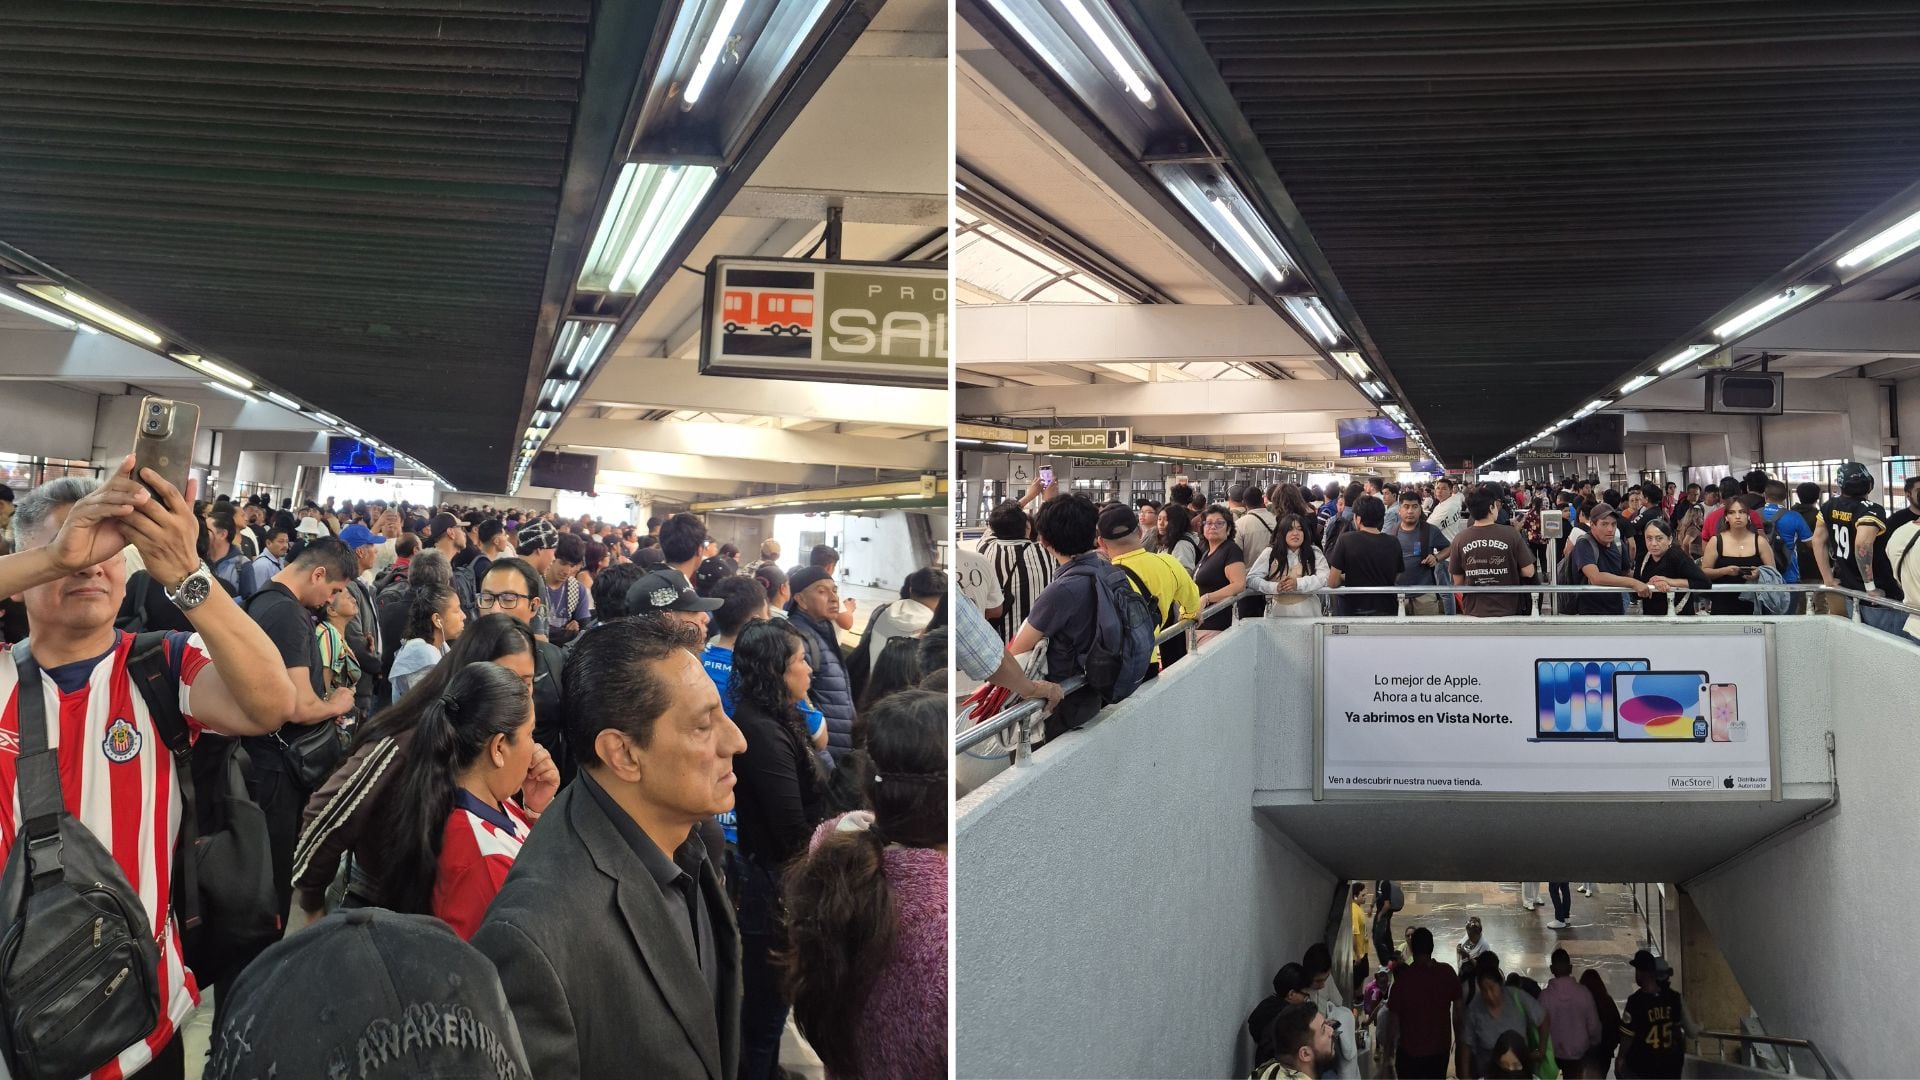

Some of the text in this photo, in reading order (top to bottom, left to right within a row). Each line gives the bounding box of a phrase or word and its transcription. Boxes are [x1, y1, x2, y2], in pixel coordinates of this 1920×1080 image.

[1049, 434, 1106, 446] SALIDA
[1462, 539, 1509, 554] ROOTS DEEP
[1832, 523, 1850, 559] 19
[1374, 674, 1481, 688] Lo mejor de Apple.
[1373, 691, 1483, 703] Ahora a tu alcance.
[1345, 711, 1513, 724] Ya abrimos en Vista Norte.
[1328, 775, 1344, 784] Ven
[1352, 776, 1392, 785] descubrir
[1393, 777, 1425, 785] nuestra
[1427, 778, 1452, 786] nueva
[1453, 777, 1483, 786] tienda.
[1671, 778, 1712, 787] MacStore
[1645, 1022, 1673, 1049] 45
